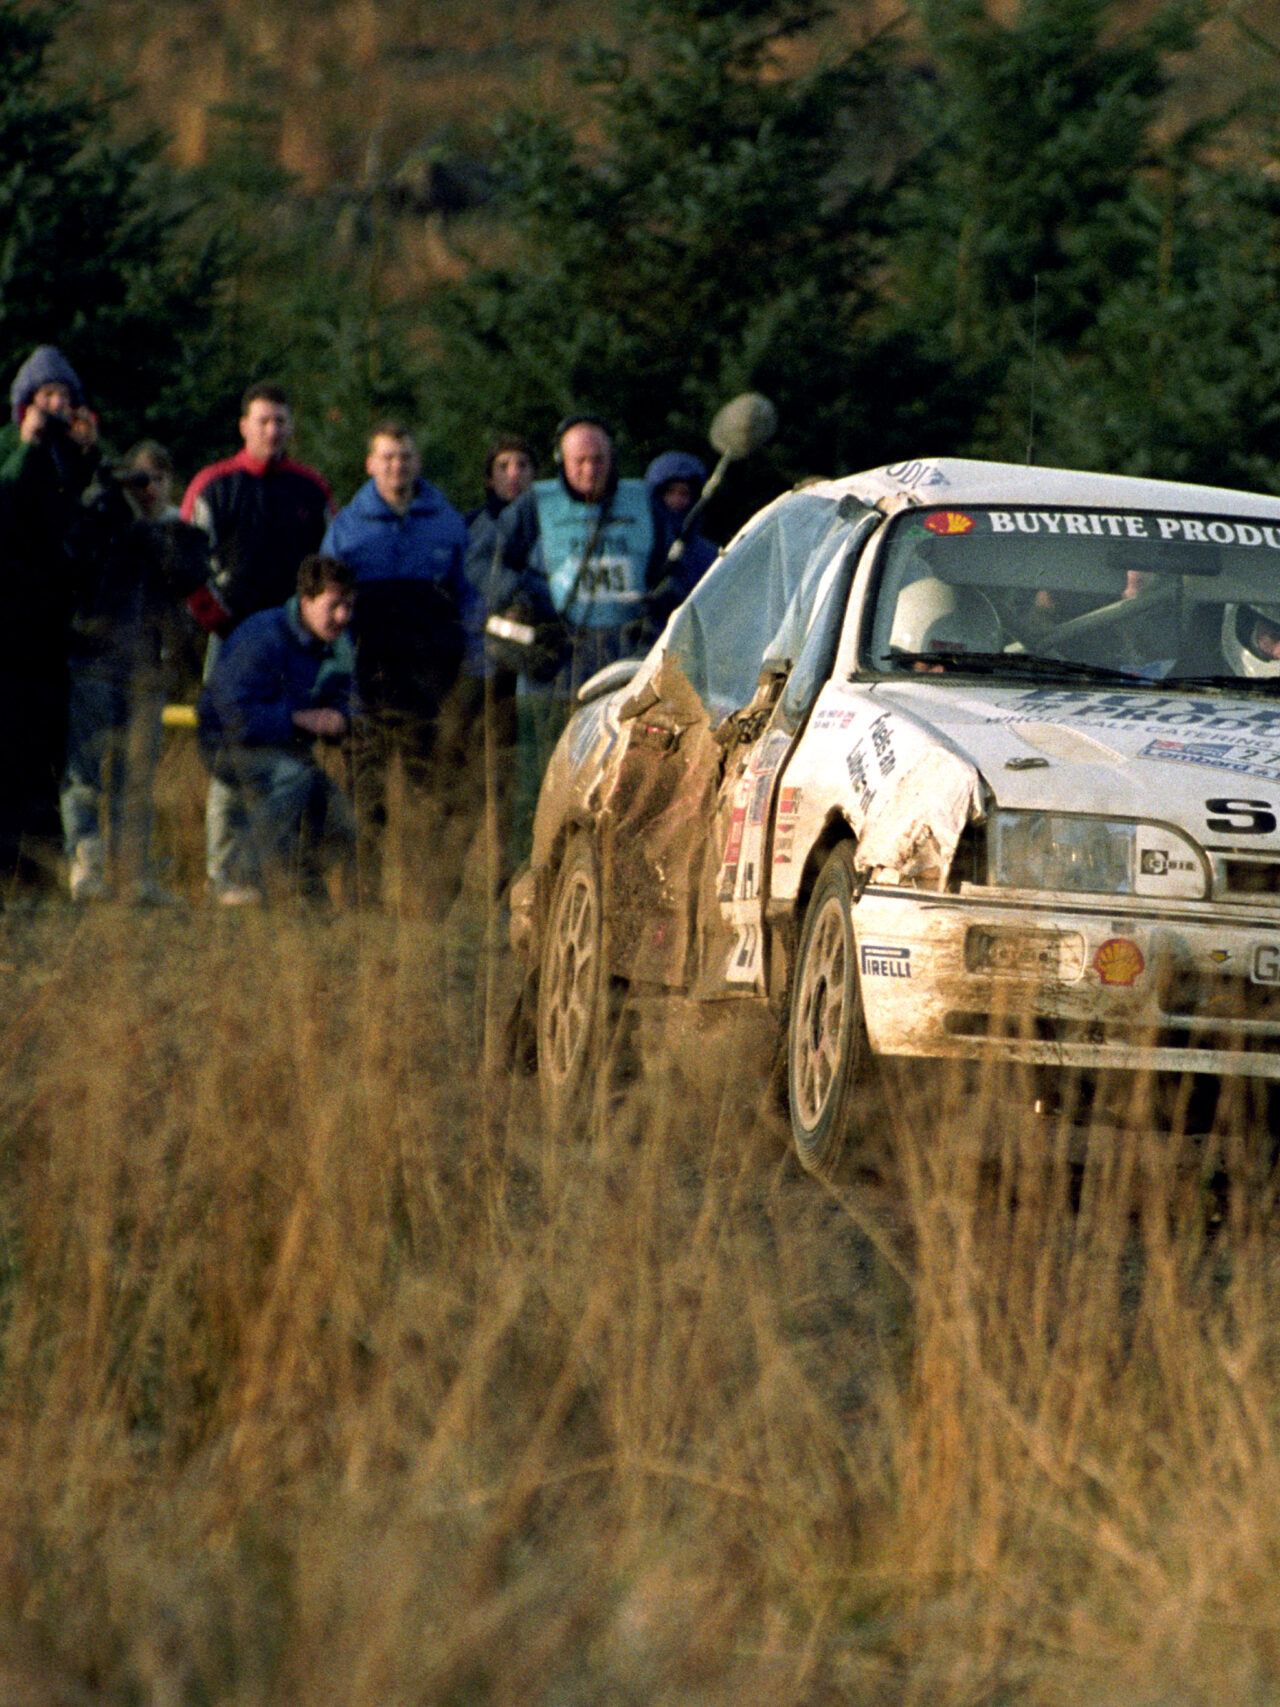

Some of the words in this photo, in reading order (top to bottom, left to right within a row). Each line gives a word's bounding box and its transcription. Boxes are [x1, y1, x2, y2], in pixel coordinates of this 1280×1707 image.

[988, 511, 1148, 537] BUYRITE
[1146, 725, 1273, 748] CATERING
[861, 945, 911, 977] PIRELLI
